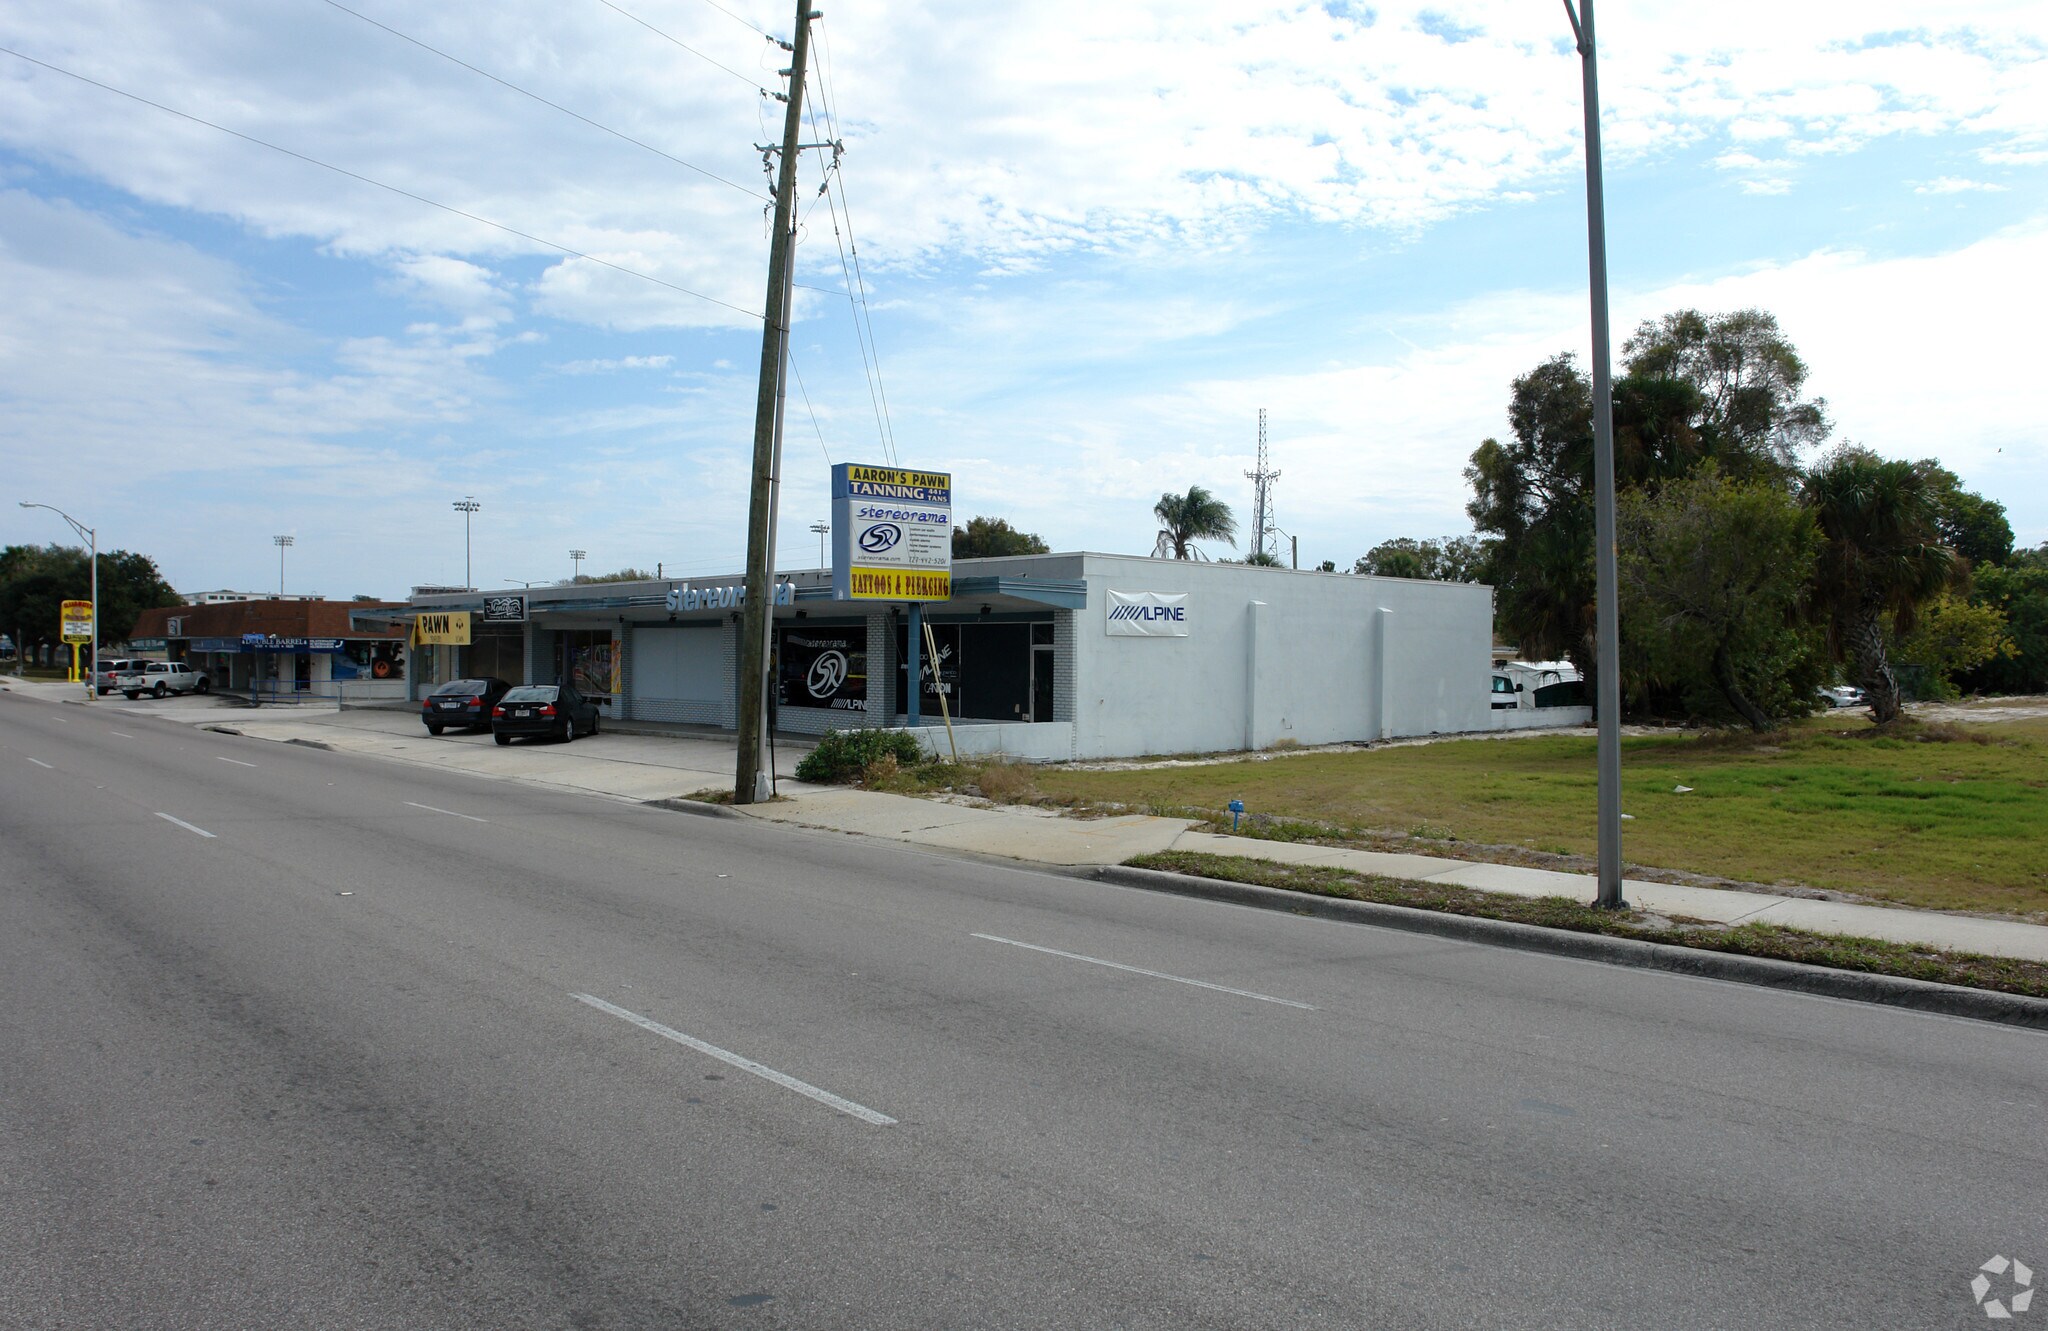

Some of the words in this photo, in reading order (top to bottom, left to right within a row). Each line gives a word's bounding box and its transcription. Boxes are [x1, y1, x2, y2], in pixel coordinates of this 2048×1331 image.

[853, 467, 907, 484] AARON'S
[912, 474, 946, 487] PAWN
[851, 481, 925, 499] TANNING
[928, 495, 948, 503] TANS
[856, 504, 949, 524] stereorama
[852, 574, 892, 595] TATTOOS
[895, 575, 902, 595] &
[905, 575, 949, 596] PIERCING
[665, 582, 796, 612] stereora
[422, 615, 450, 633] PAWN
